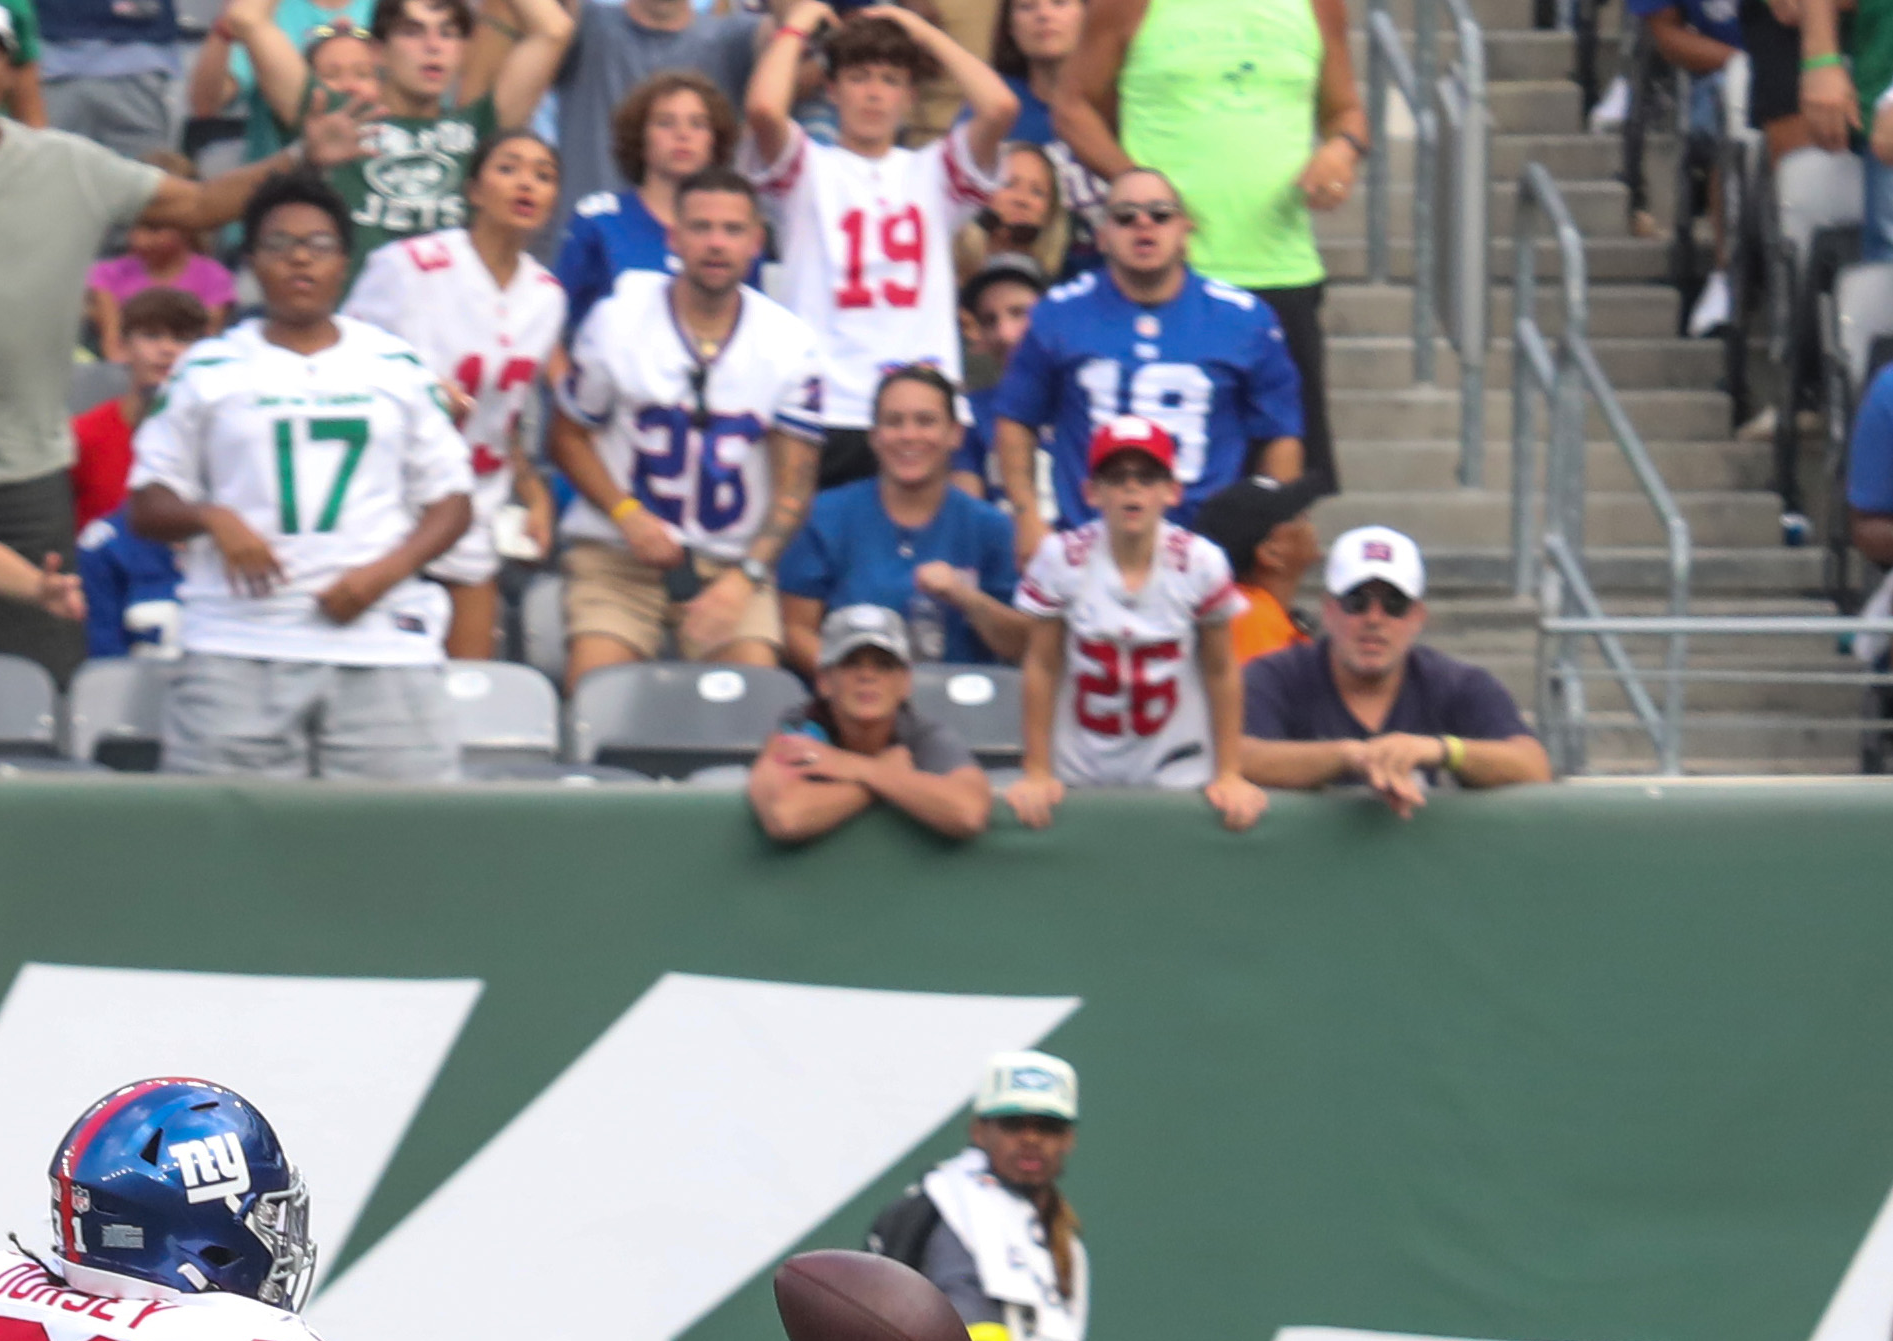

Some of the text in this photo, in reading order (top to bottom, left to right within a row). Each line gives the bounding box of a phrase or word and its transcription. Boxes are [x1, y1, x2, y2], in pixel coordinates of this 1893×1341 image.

[835, 204, 923, 308] 19
[275, 416, 369, 534] 17
[632, 404, 765, 532] 26
[1075, 640, 1183, 737] 26
